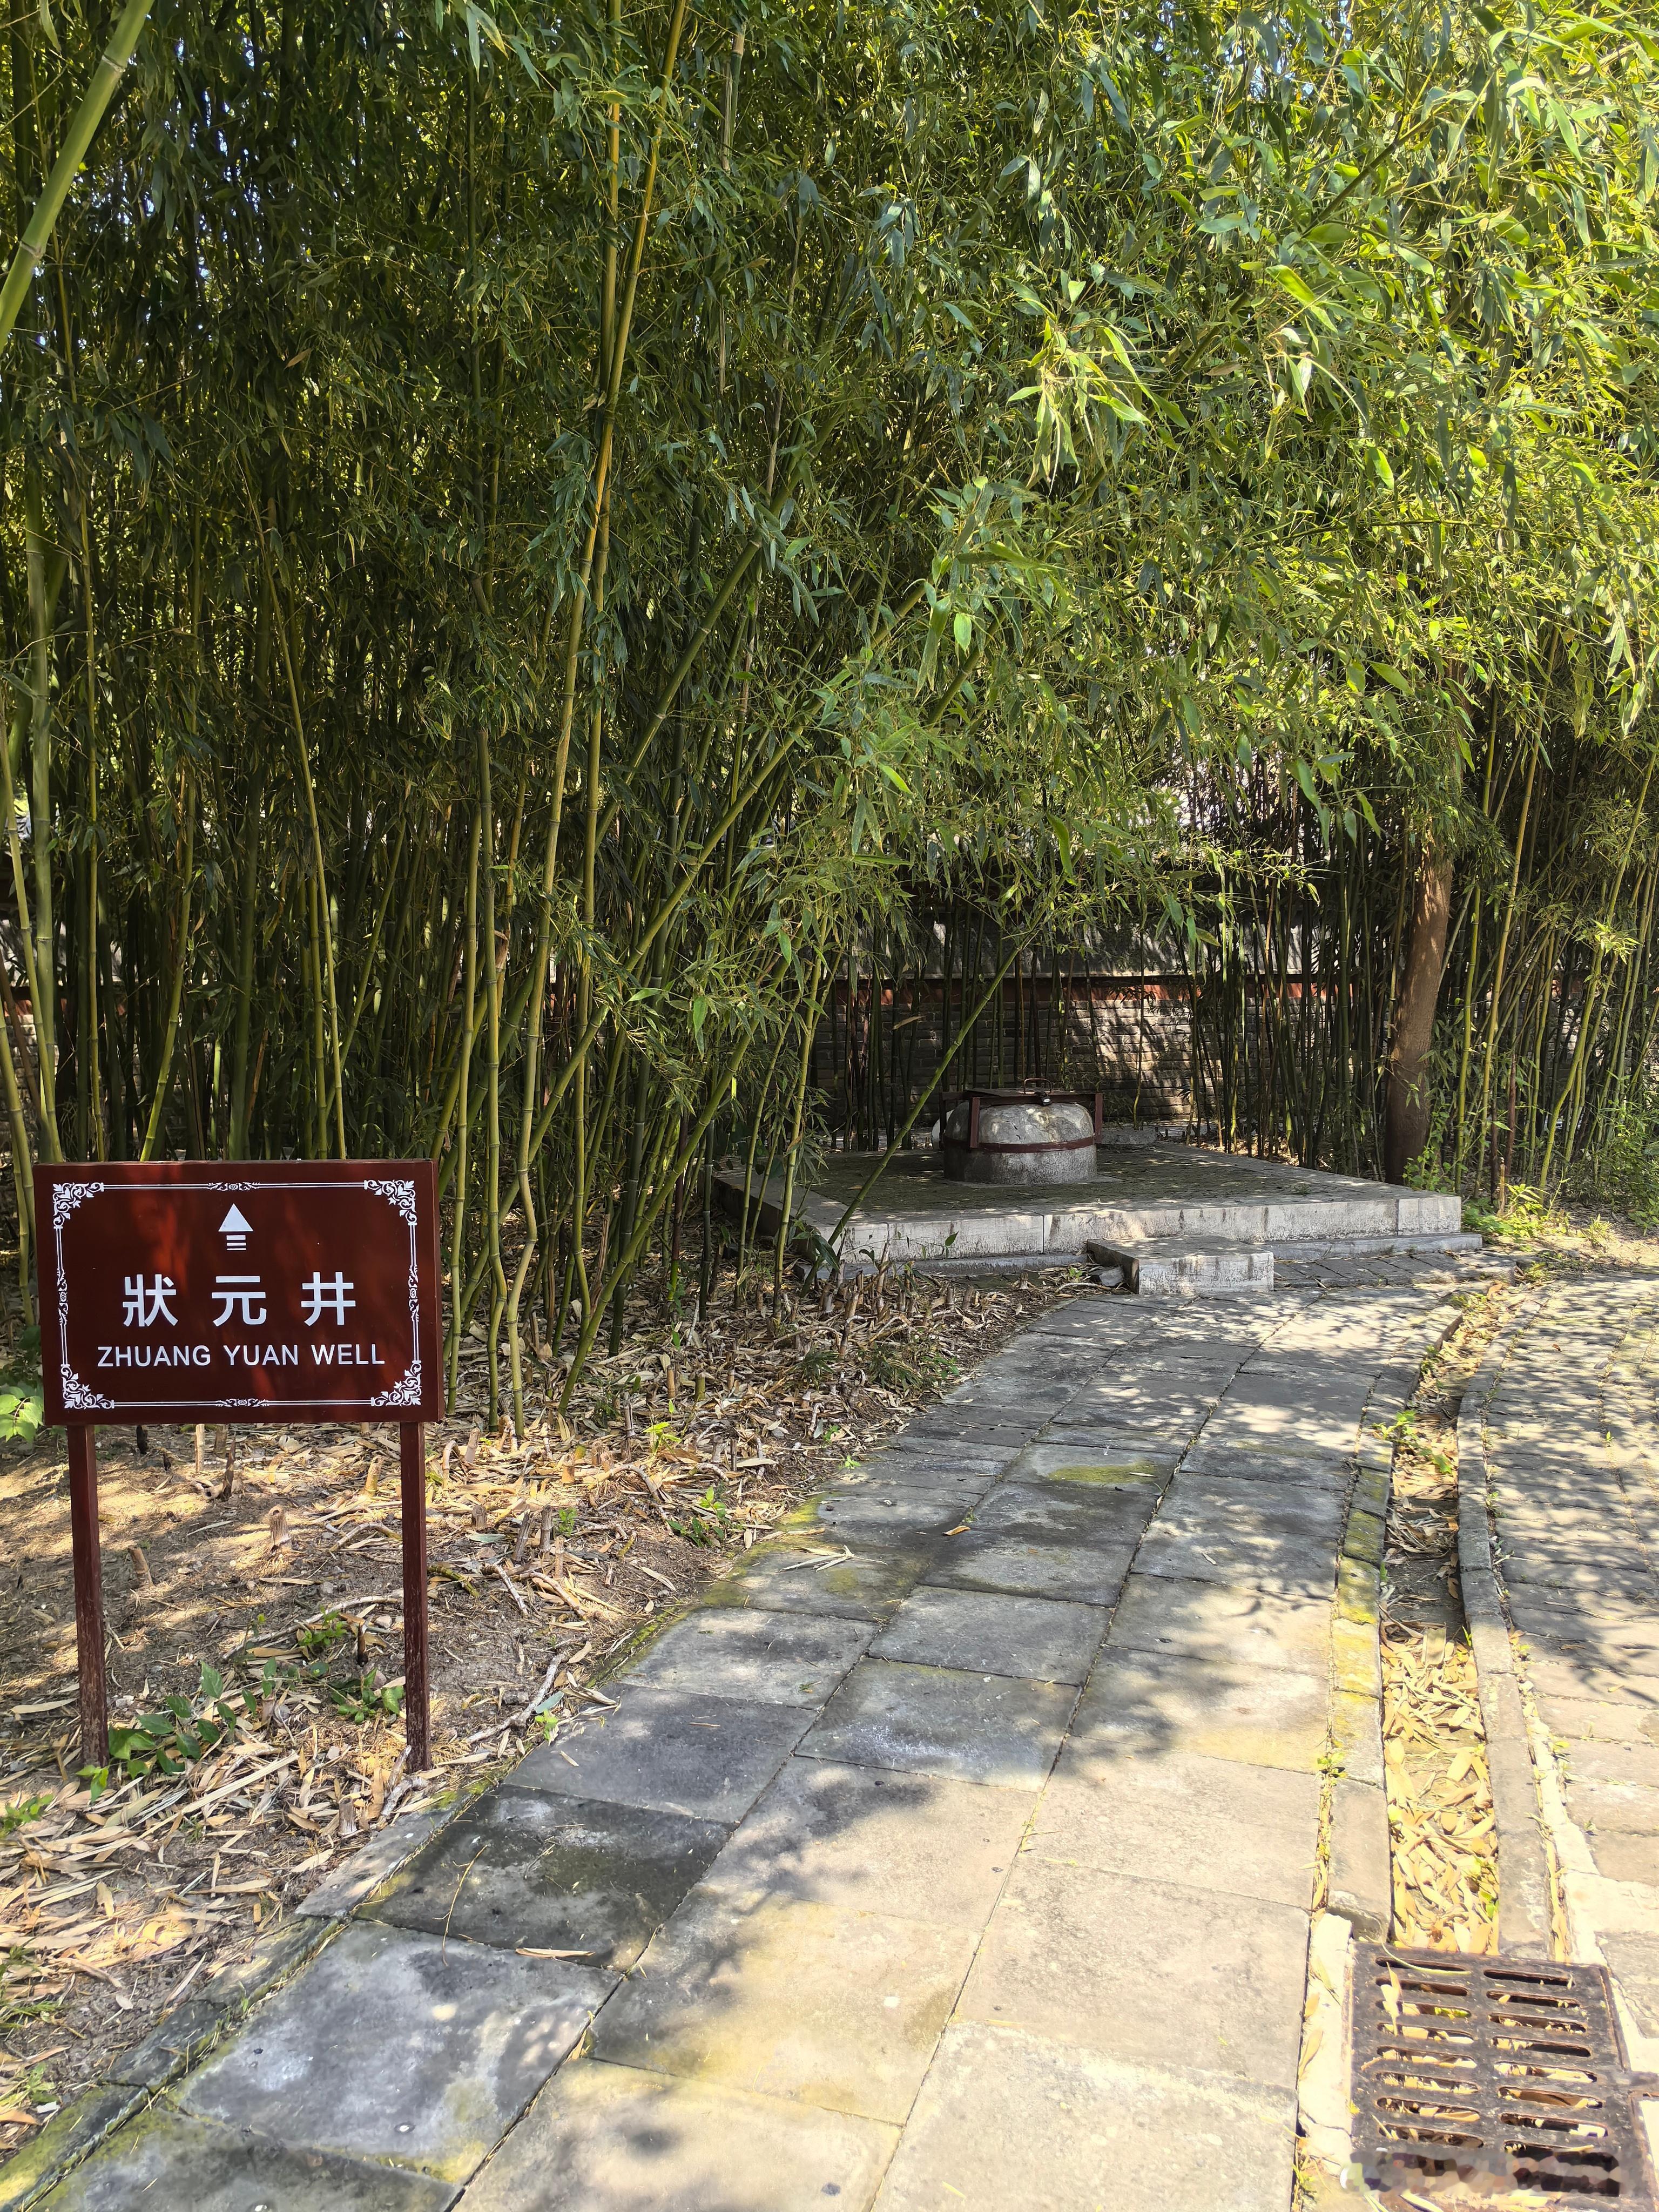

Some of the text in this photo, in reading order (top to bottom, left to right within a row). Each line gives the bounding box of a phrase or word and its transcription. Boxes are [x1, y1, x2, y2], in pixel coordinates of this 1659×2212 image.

[97, 1343, 386, 1367] ZHUANG YUAN WELL
